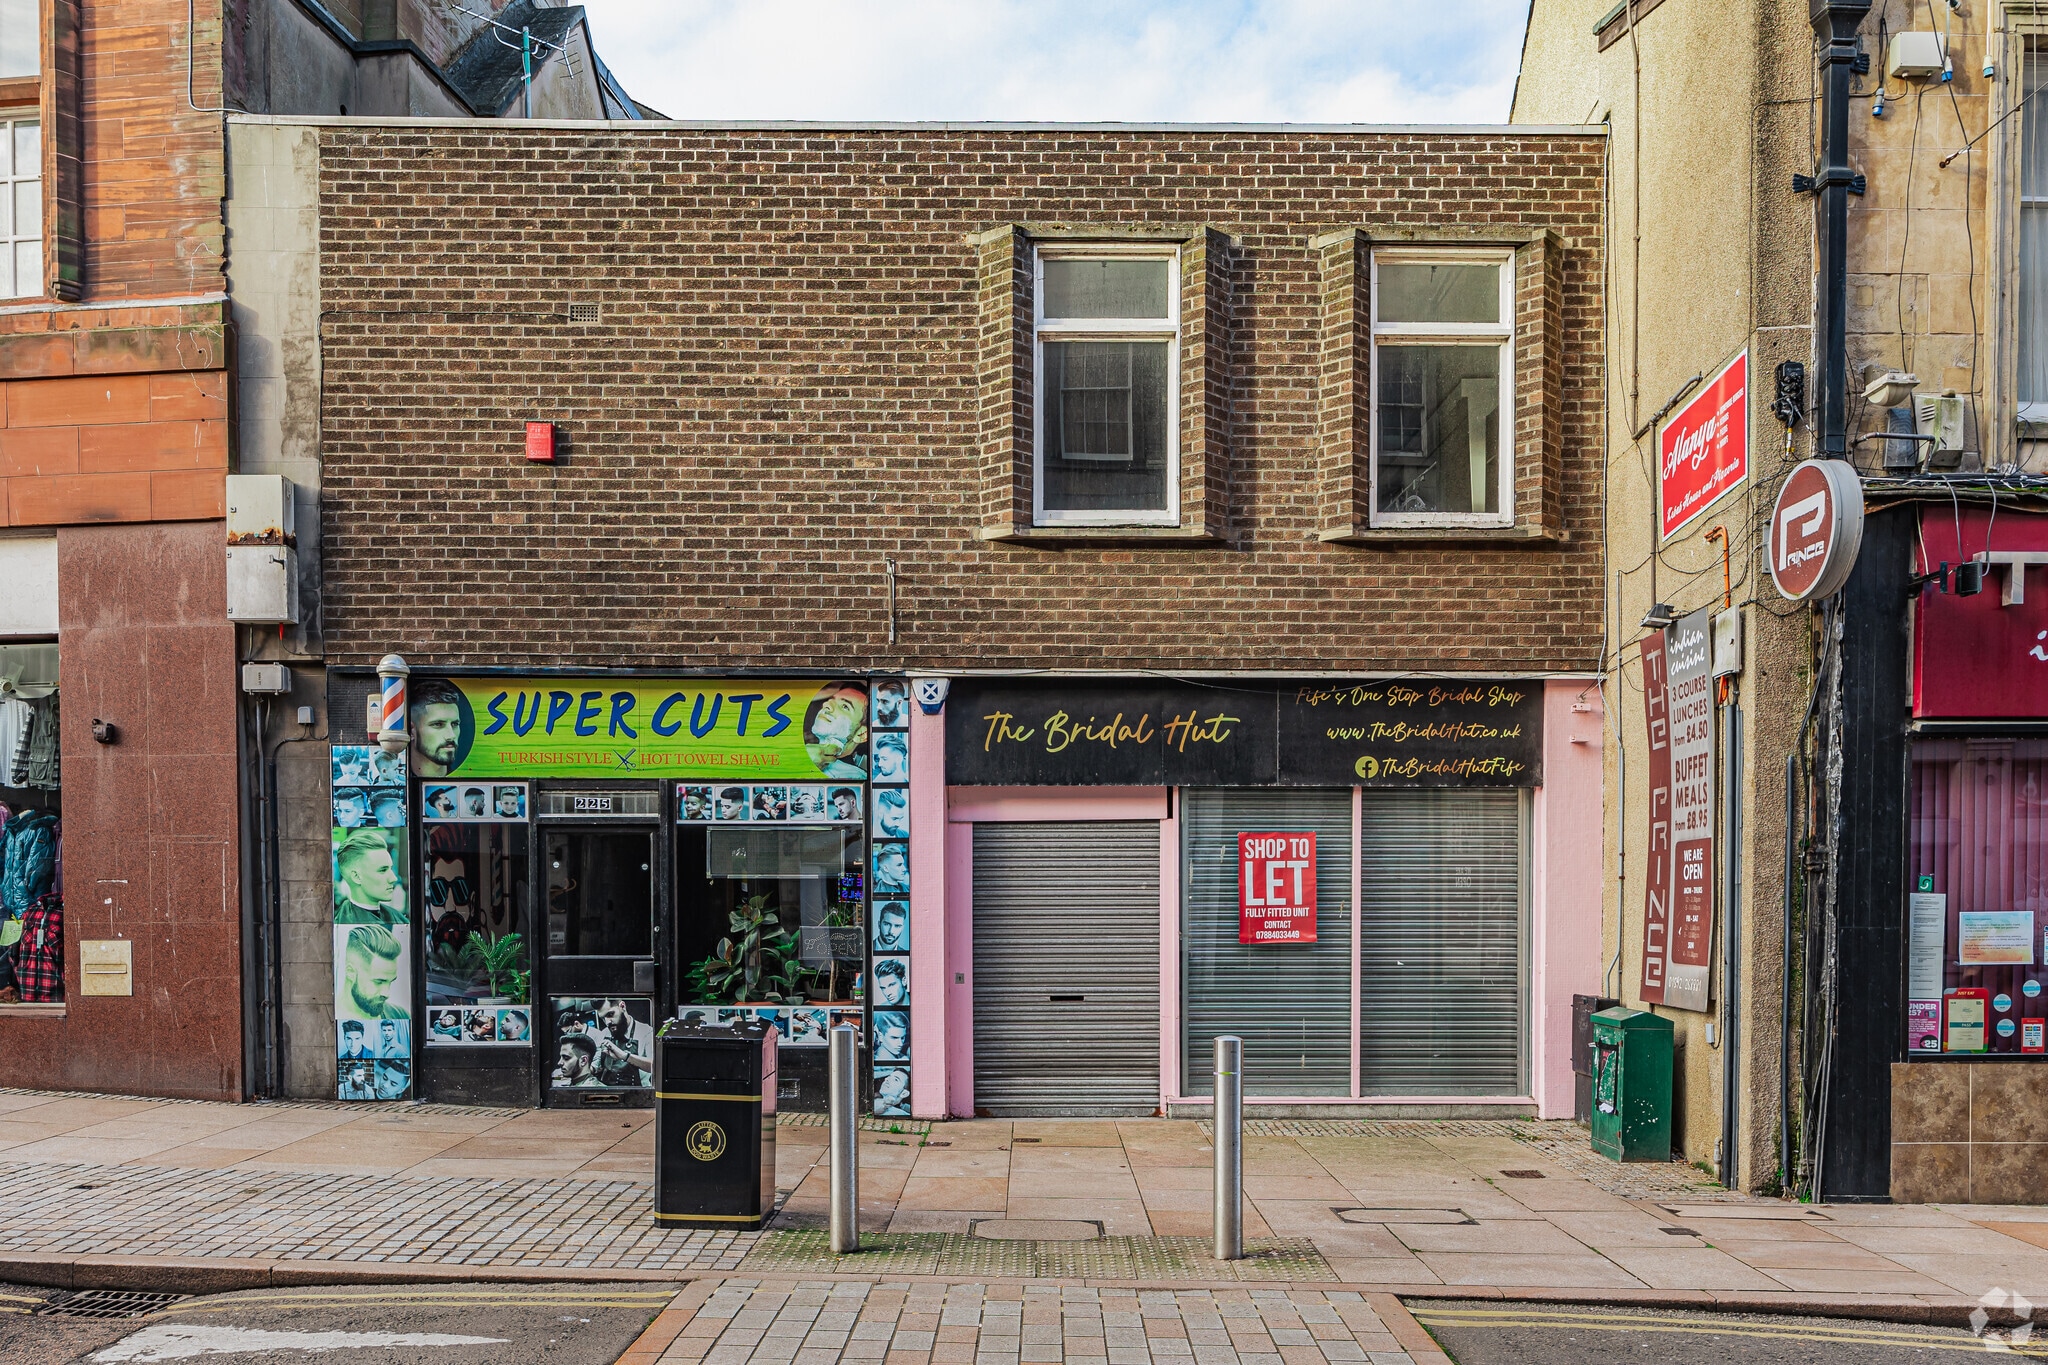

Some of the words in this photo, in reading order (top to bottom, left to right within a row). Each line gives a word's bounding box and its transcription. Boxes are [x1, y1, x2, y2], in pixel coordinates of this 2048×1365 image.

[1663, 414, 1717, 481] Alanya
[1669, 629, 1704, 655] indian
[1296, 685, 1346, 705] Fife's
[1350, 686, 1383, 706] One
[1386, 685, 1424, 707] Stop
[1428, 685, 1484, 707] Bridal
[1487, 685, 1526, 707] Shop
[1672, 687, 1677, 703] 3
[1678, 675, 1707, 700] COURSE
[483, 691, 638, 739] SUPER
[651, 691, 792, 739] CUTS
[1673, 698, 1708, 725] LUNCHES
[983, 710, 1035, 752] The
[1044, 709, 1154, 752] Bridal
[1163, 709, 1240, 752] Hut
[1674, 734, 1685, 747] from
[1686, 719, 1708, 744] £4.50
[498, 752, 563, 766] TURKISH
[566, 752, 612, 766] STYLE
[641, 753, 672, 766] HOT
[675, 753, 729, 766] TOWEL
[730, 753, 780, 767] SHAVE
[1382, 757, 1525, 778] TheBridalHutFife
[1675, 752, 1709, 784] BUFFET
[575, 797, 611, 810] 225
[1675, 781, 1708, 809] MEALS
[1675, 818, 1685, 832] from
[1686, 808, 1708, 831] £8.95
[1245, 838, 1287, 859] SHOP
[1289, 838, 1310, 859] TO
[1683, 849, 1692, 862] WE
[1692, 848, 1703, 861] ARE
[1245, 860, 1309, 906] LET
[1683, 862, 1703, 881] OPEN
[1245, 908, 1266, 918] FULLY
[1267, 907, 1292, 917] FITTED
[1293, 907, 1310, 917] UNIT
[1264, 920, 1292, 929] CONTACT
[816, 942, 857, 956] OPEN
